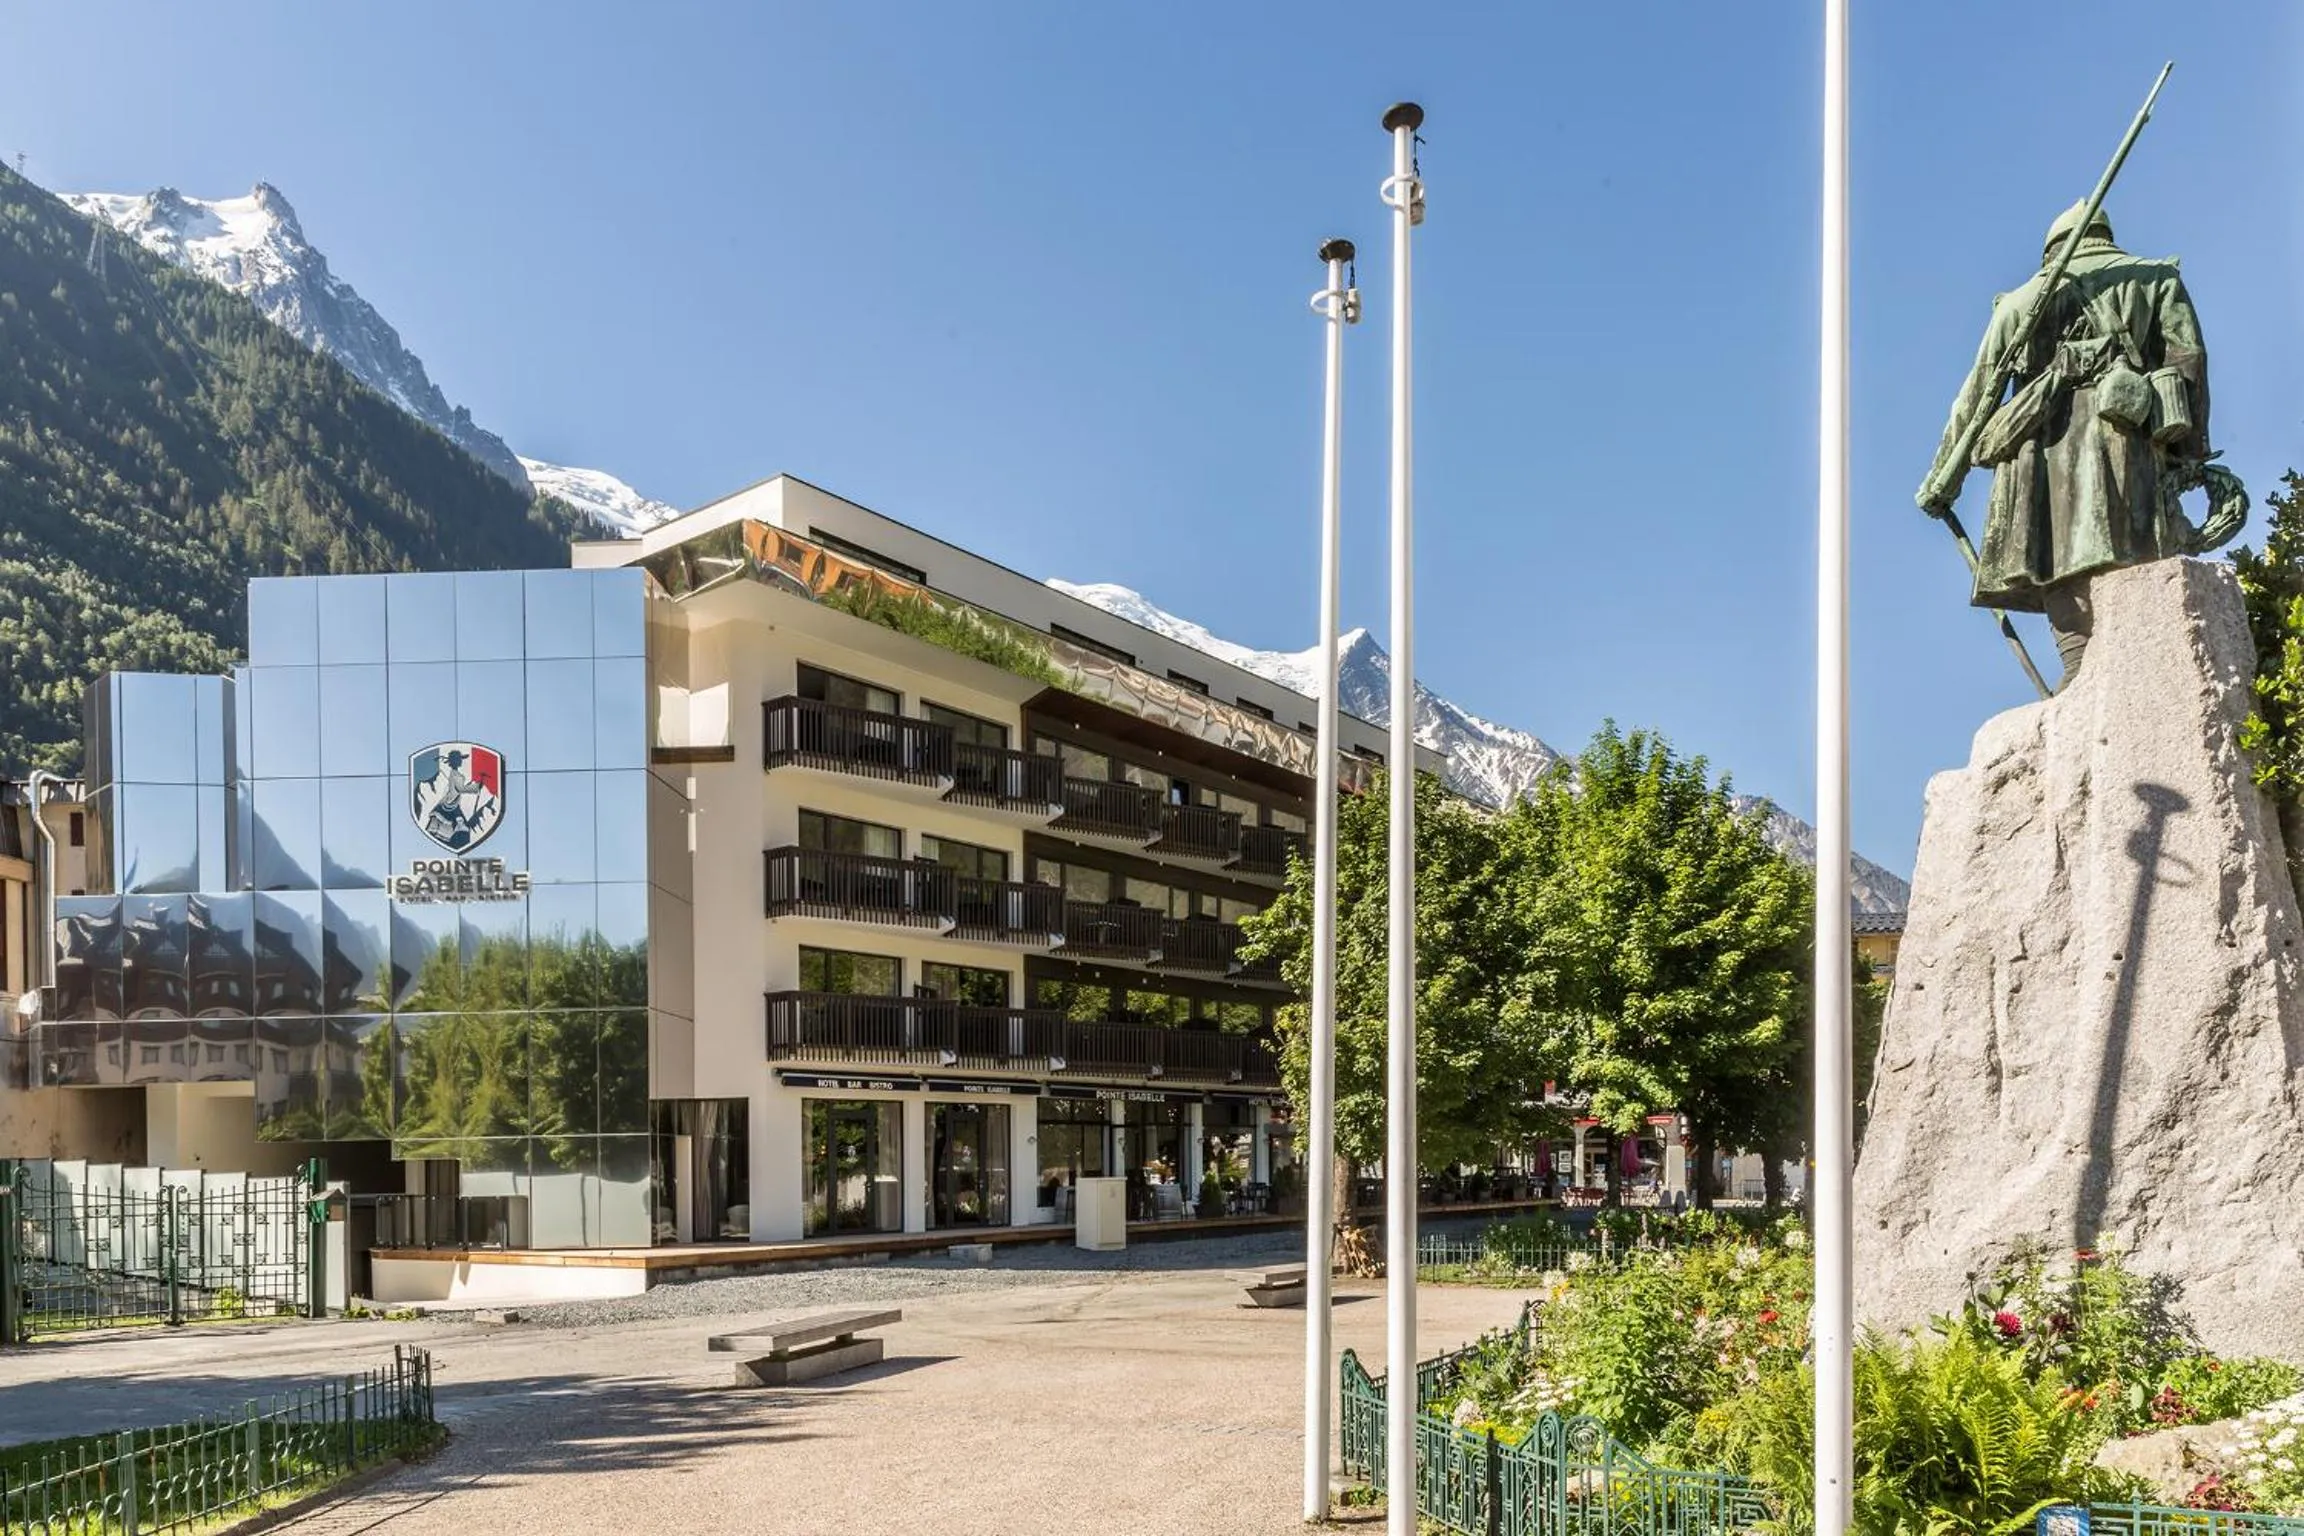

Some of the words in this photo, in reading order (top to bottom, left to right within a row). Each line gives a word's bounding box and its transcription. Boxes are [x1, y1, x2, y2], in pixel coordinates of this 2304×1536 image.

[413, 859, 503, 875] POINTE
[386, 873, 529, 894] ISABELLE
[817, 1079, 839, 1088] HOTEL
[1096, 1089, 1125, 1100] POINTE
